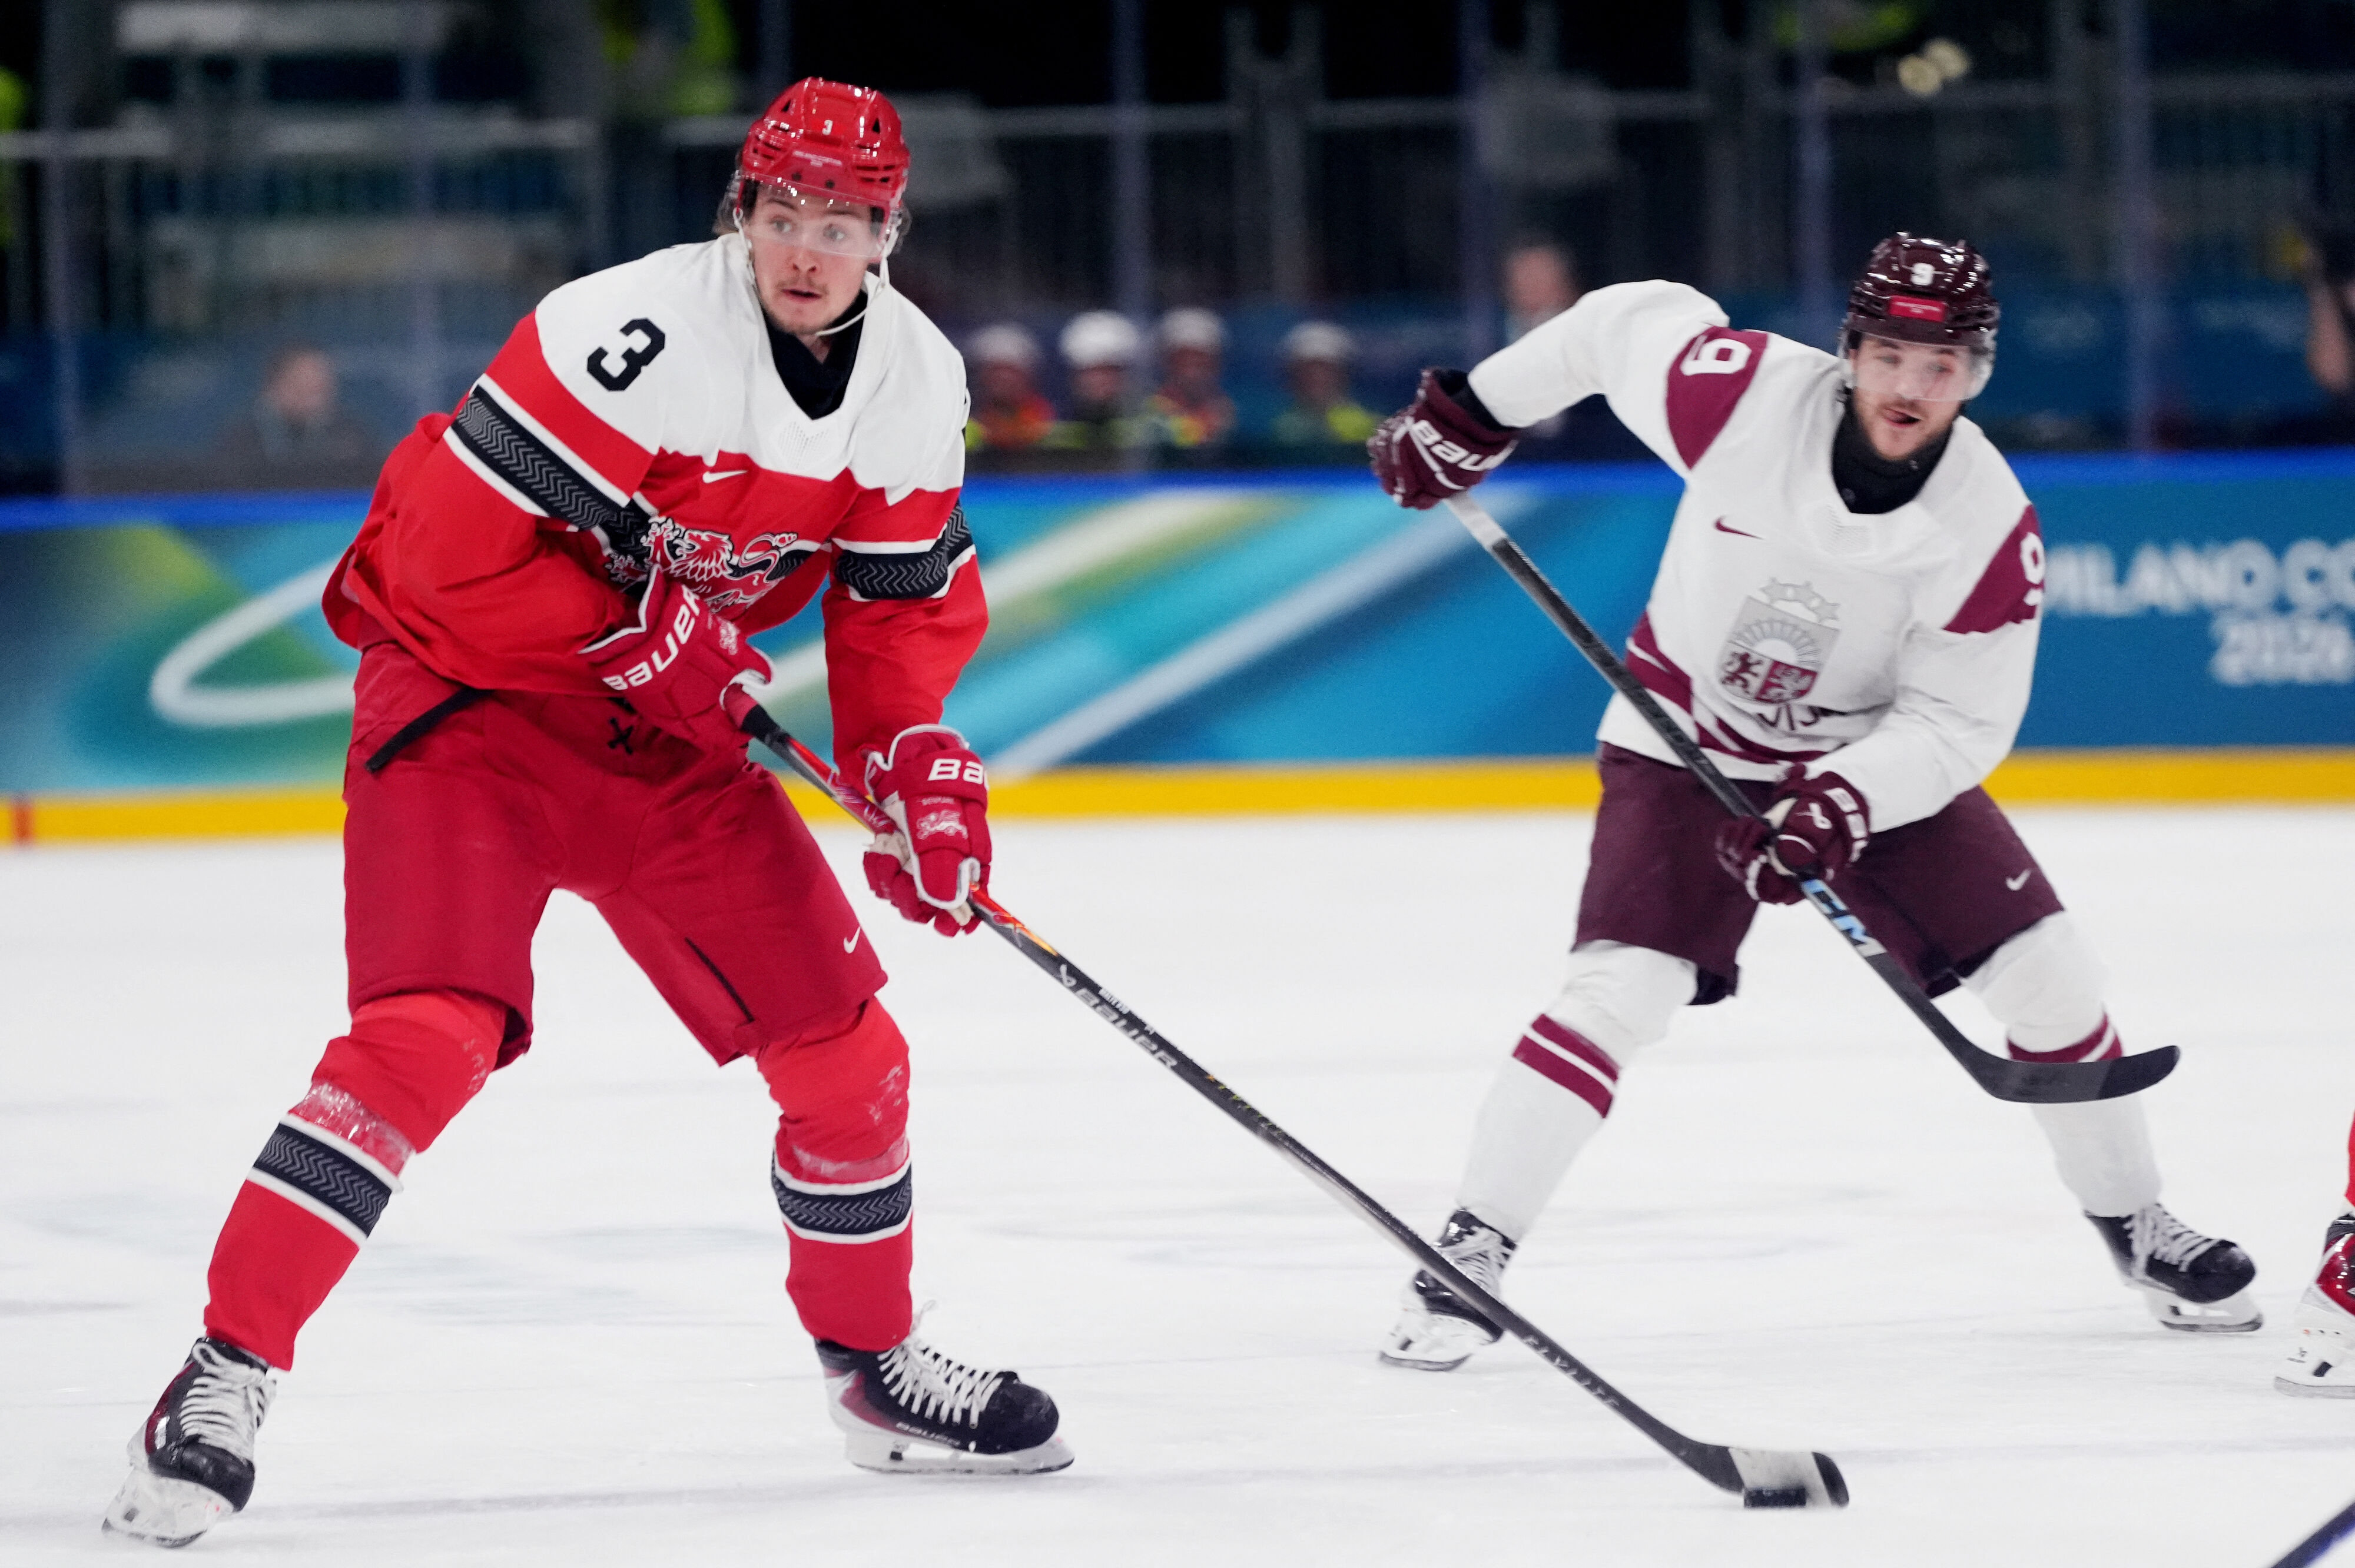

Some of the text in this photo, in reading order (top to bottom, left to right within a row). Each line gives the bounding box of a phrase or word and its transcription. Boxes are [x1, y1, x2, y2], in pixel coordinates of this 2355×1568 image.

[822, 119, 833, 135] 3
[1910, 263, 1935, 286] 9
[586, 317, 665, 392] 3
[1680, 334, 1752, 377] 9
